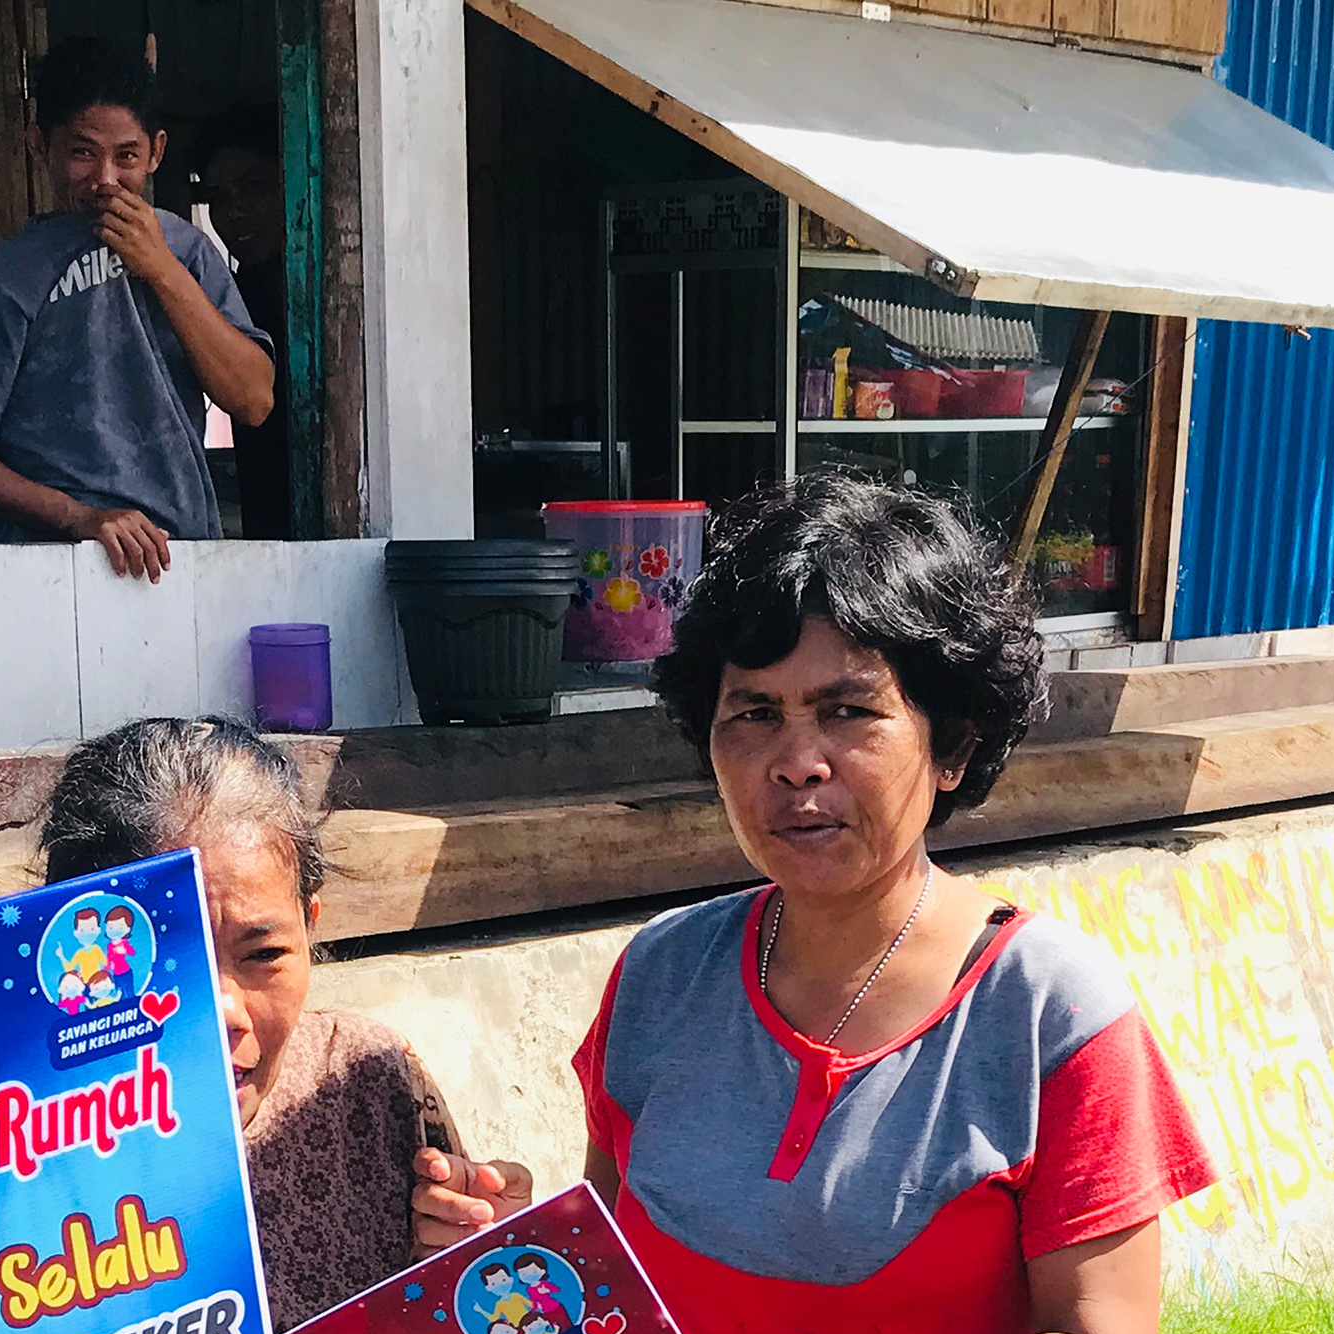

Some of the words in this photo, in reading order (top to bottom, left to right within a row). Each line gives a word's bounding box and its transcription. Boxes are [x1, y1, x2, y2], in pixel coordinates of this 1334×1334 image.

[58, 1018, 110, 1044] SAYANGI
[113, 1008, 138, 1027] DIRI
[60, 1042, 86, 1060] DAN
[89, 1020, 154, 1051] KELUARGA
